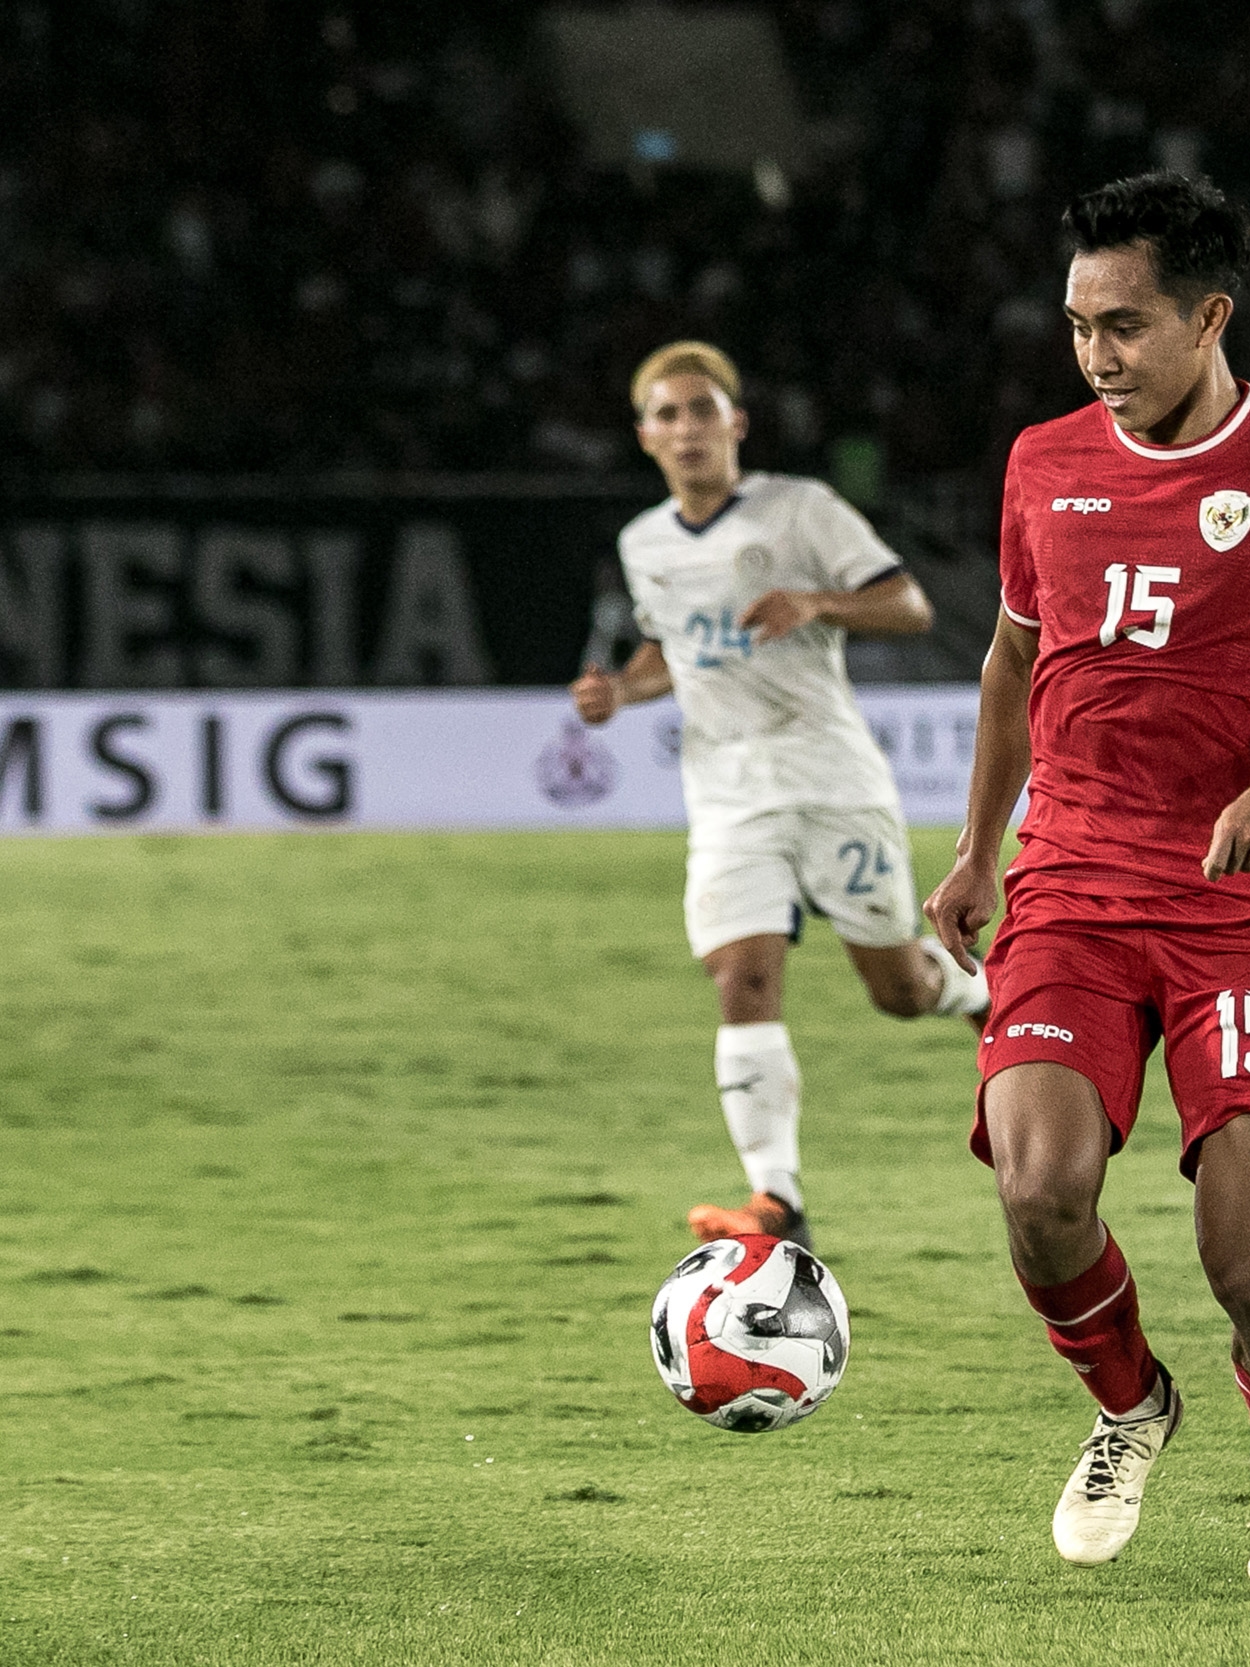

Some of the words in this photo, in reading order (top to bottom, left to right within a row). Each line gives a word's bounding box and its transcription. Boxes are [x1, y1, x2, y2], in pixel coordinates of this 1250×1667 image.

[1051, 497, 1112, 515] erspo
[1100, 562, 1182, 650] 15
[1007, 1023, 1073, 1043] erspo
